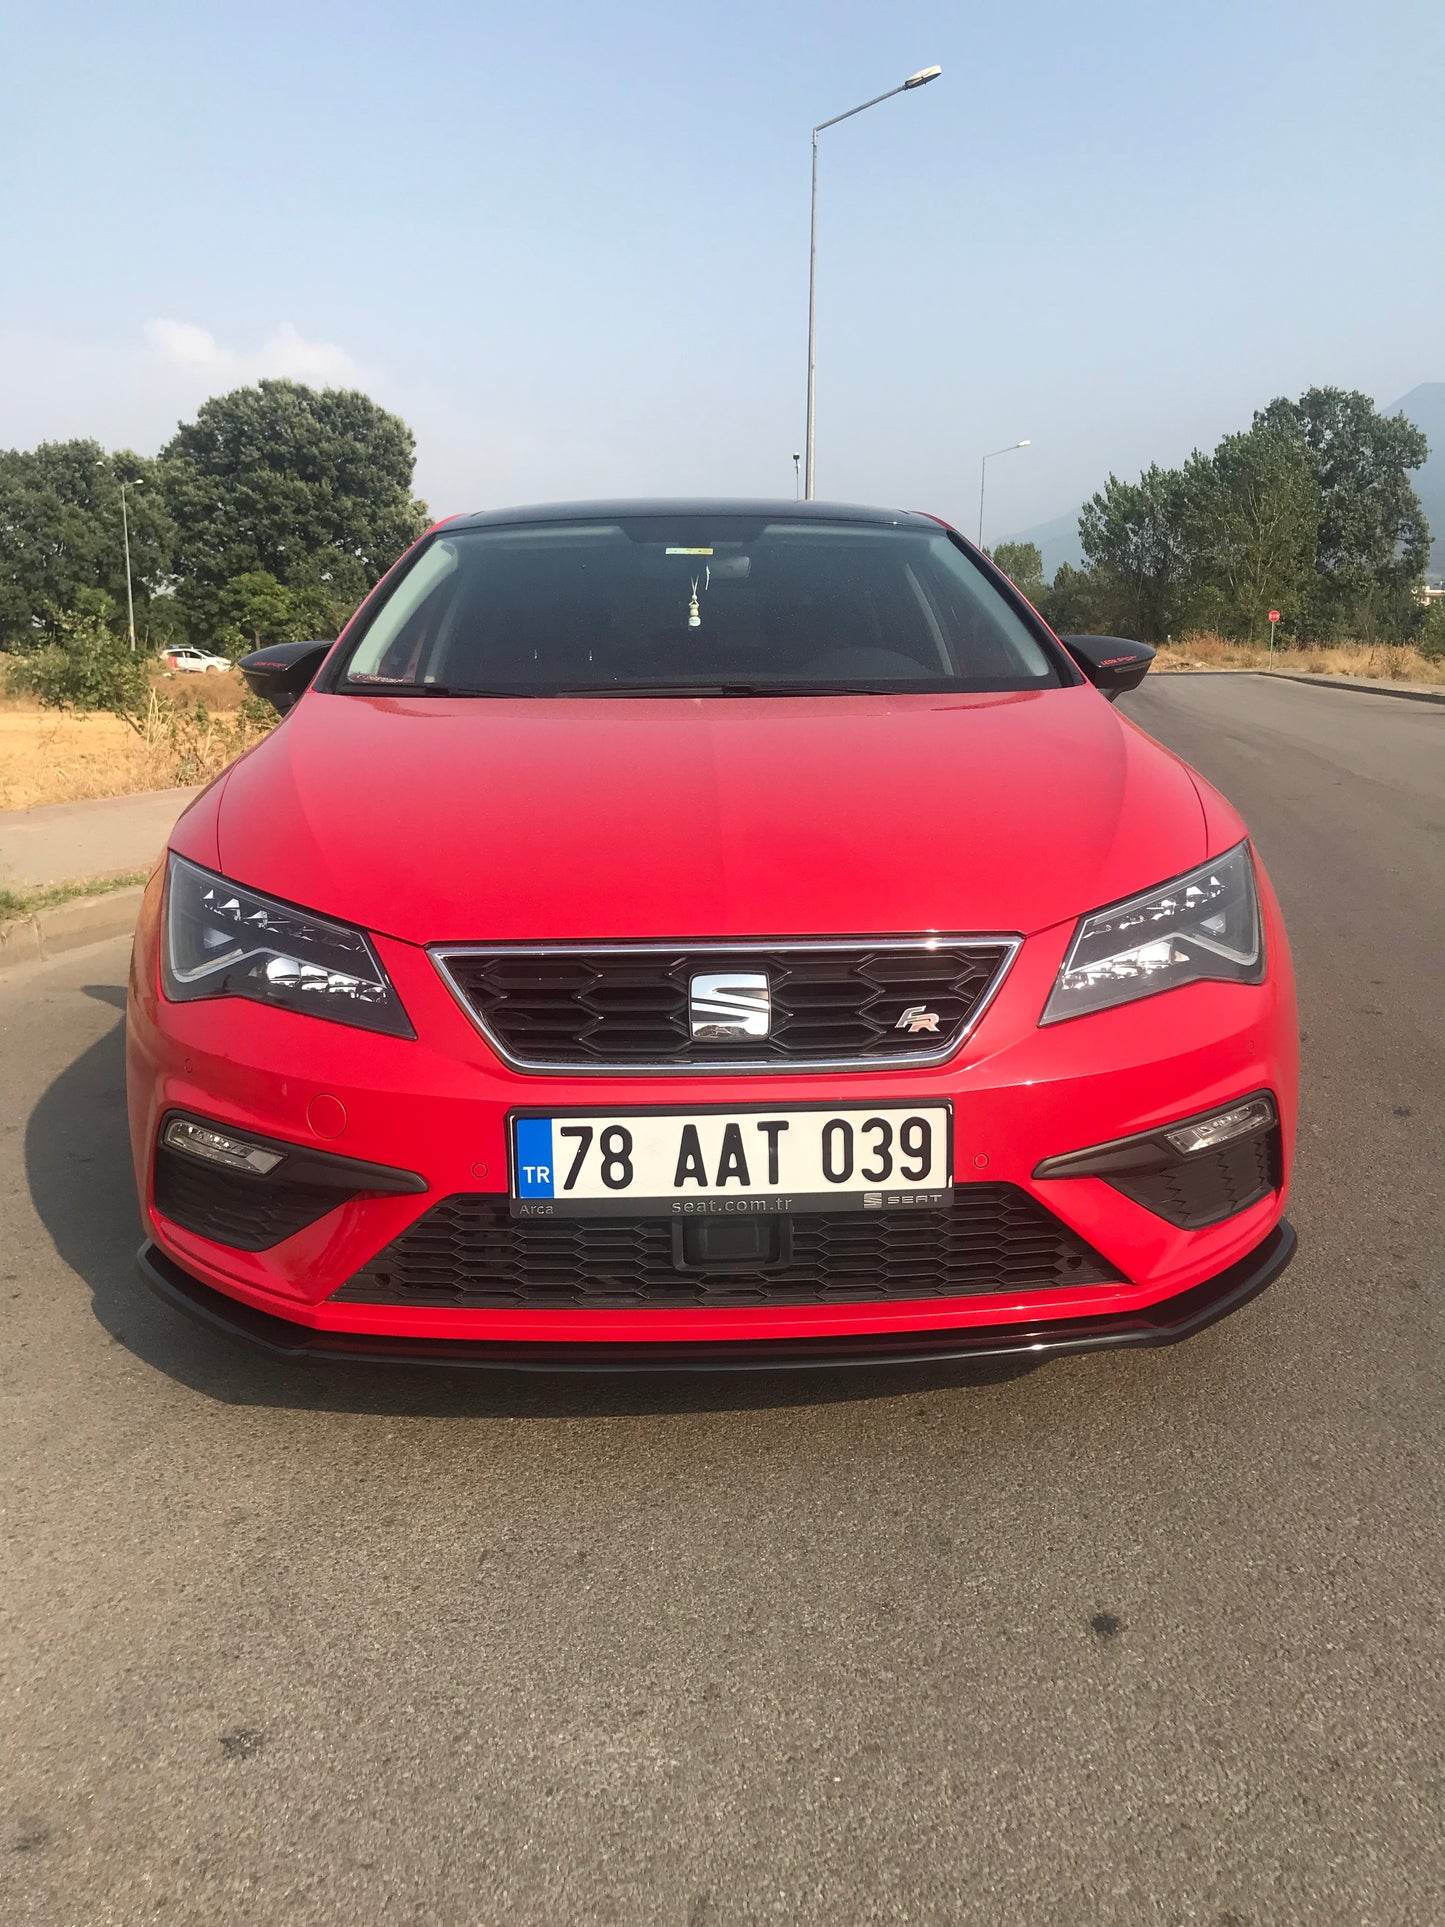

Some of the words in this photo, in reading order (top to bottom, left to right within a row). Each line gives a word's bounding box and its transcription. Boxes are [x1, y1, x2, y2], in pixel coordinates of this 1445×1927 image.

[895, 1005, 940, 1032] FR
[560, 1124, 634, 1190] 78
[673, 1121, 790, 1188] AAT
[821, 1117, 932, 1184] 039
[522, 1166, 550, 1184] TR
[671, 1197, 792, 1214] seat.com.tr
[887, 1194, 943, 1205] SEAT
[519, 1204, 554, 1215] Arca
